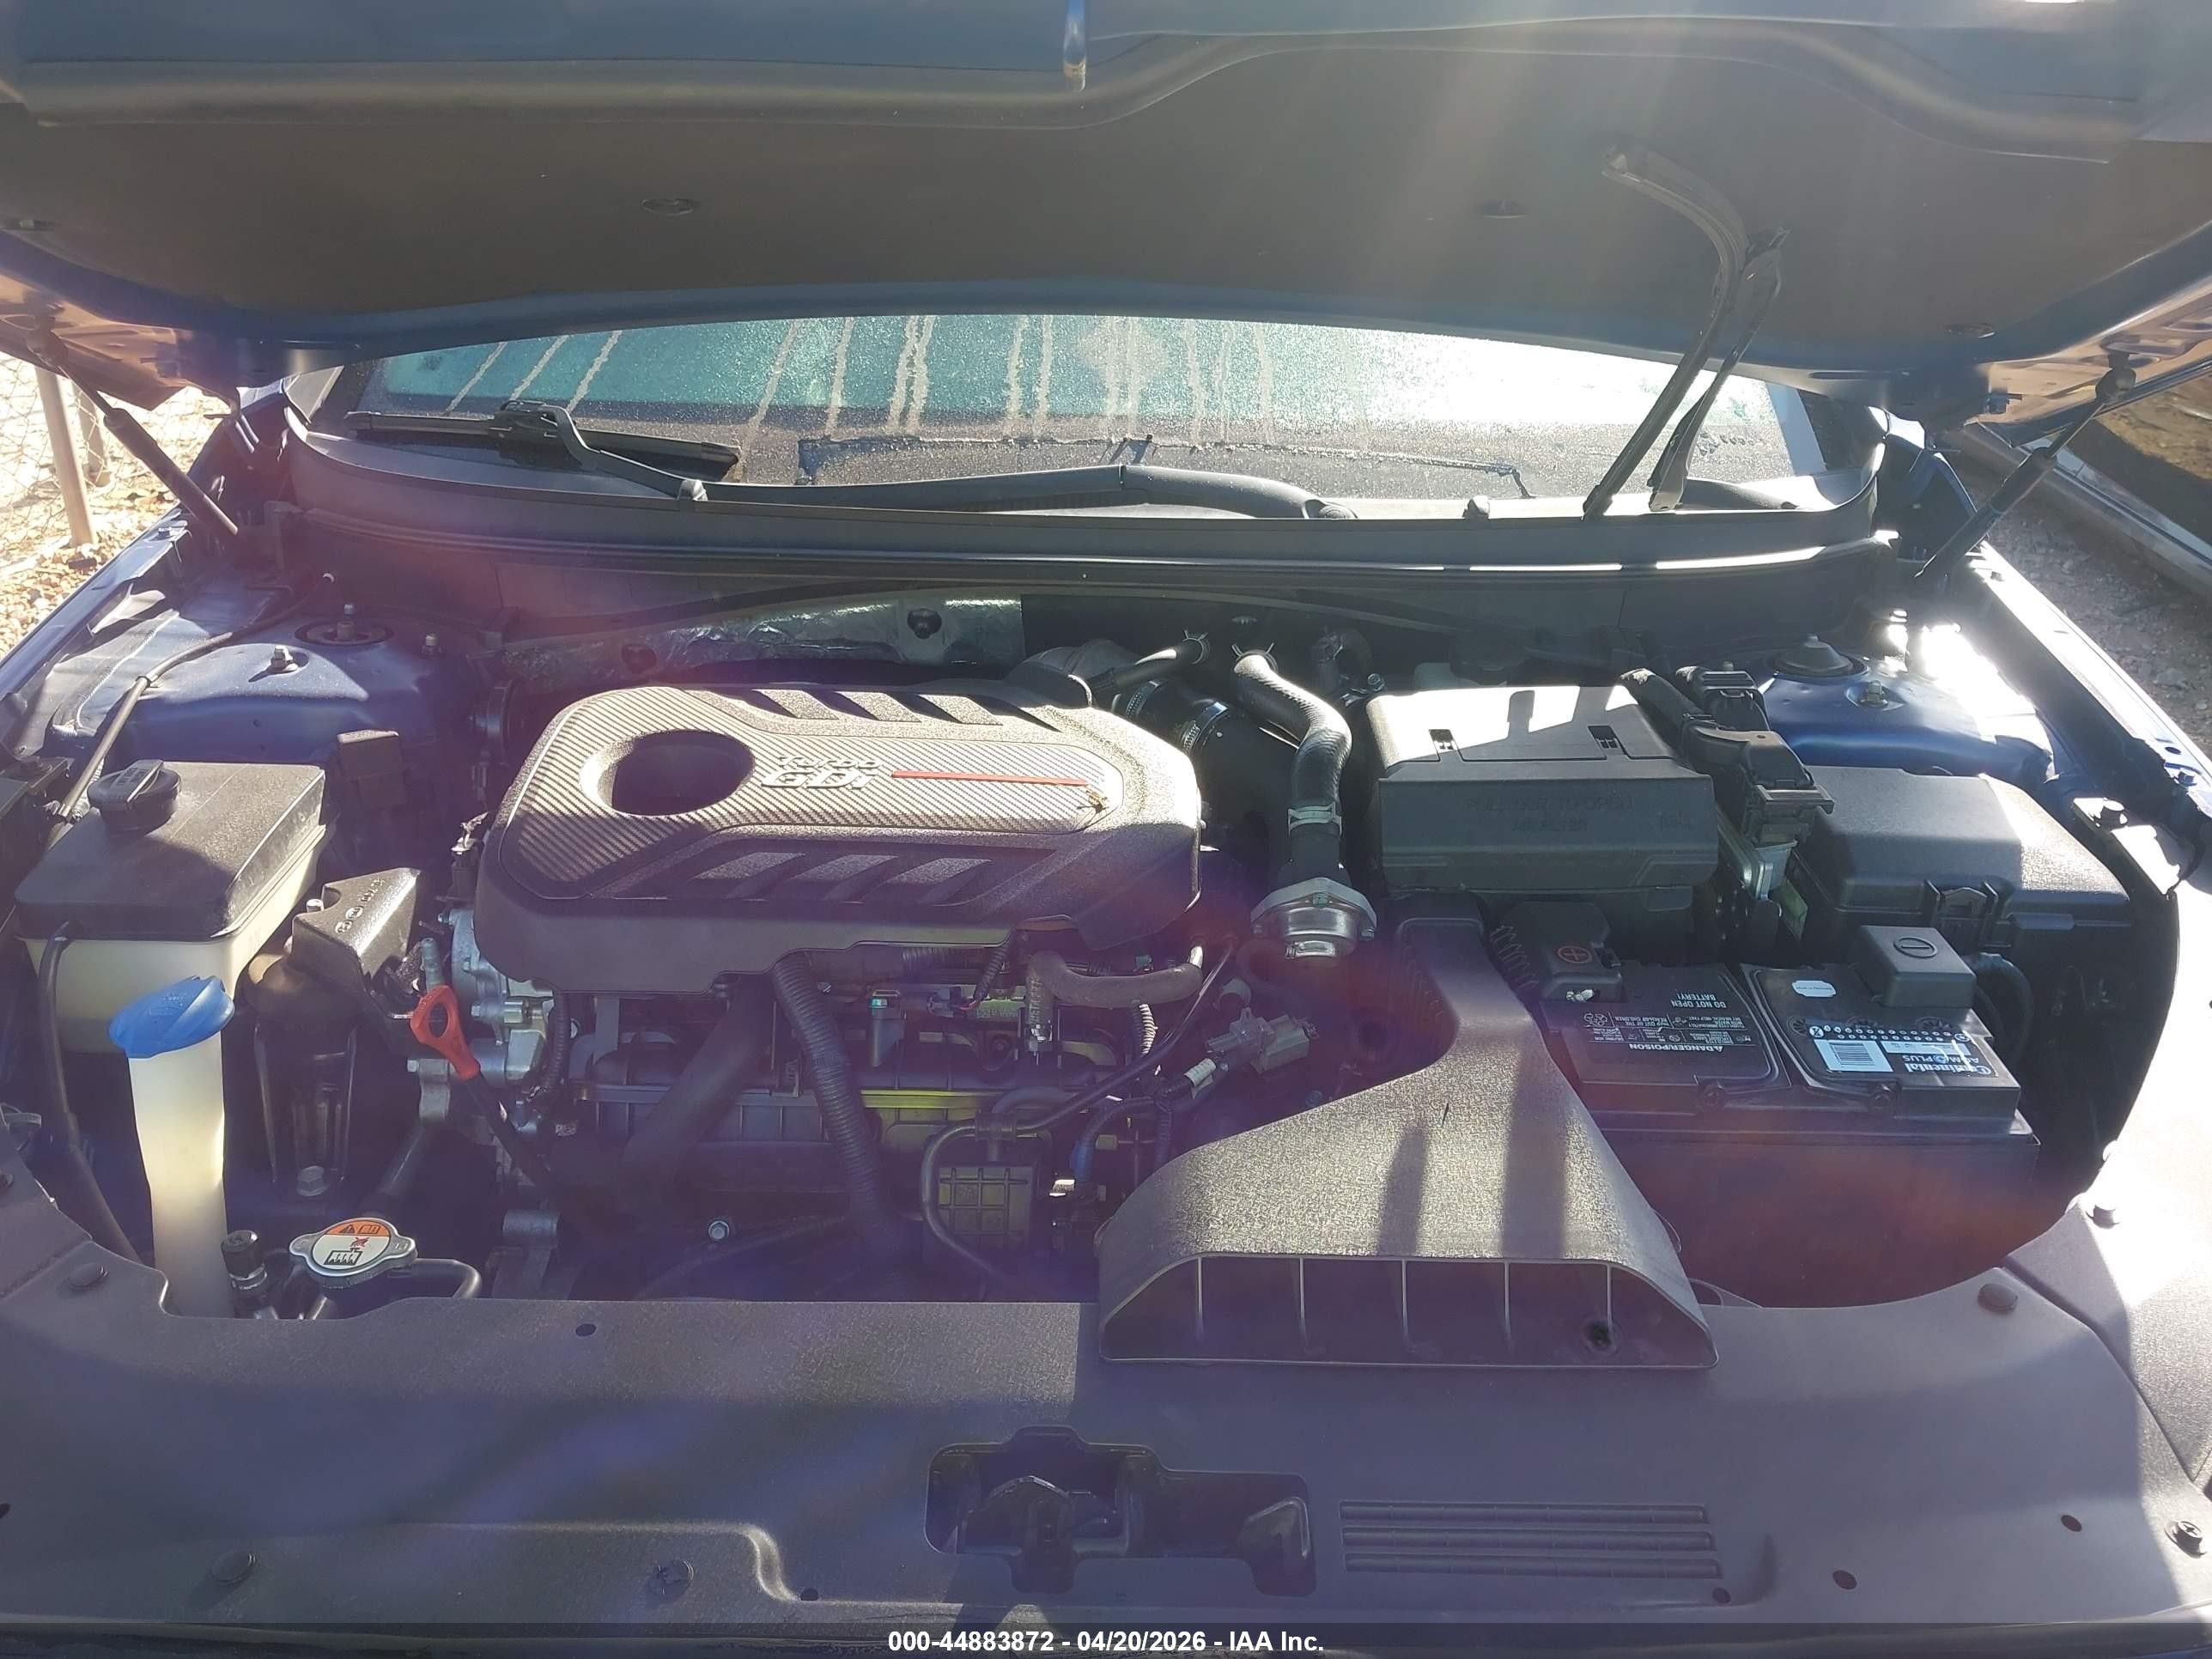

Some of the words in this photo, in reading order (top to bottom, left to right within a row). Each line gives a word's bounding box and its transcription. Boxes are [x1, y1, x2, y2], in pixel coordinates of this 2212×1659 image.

[1671, 1000, 1694, 1009] OPEN
[1695, 1000, 1712, 1009] NOT
[1713, 1000, 1727, 1009] DO
[1629, 1043, 1715, 1053] DANGER/POISON
[1902, 1054, 1934, 1063] PLUS
